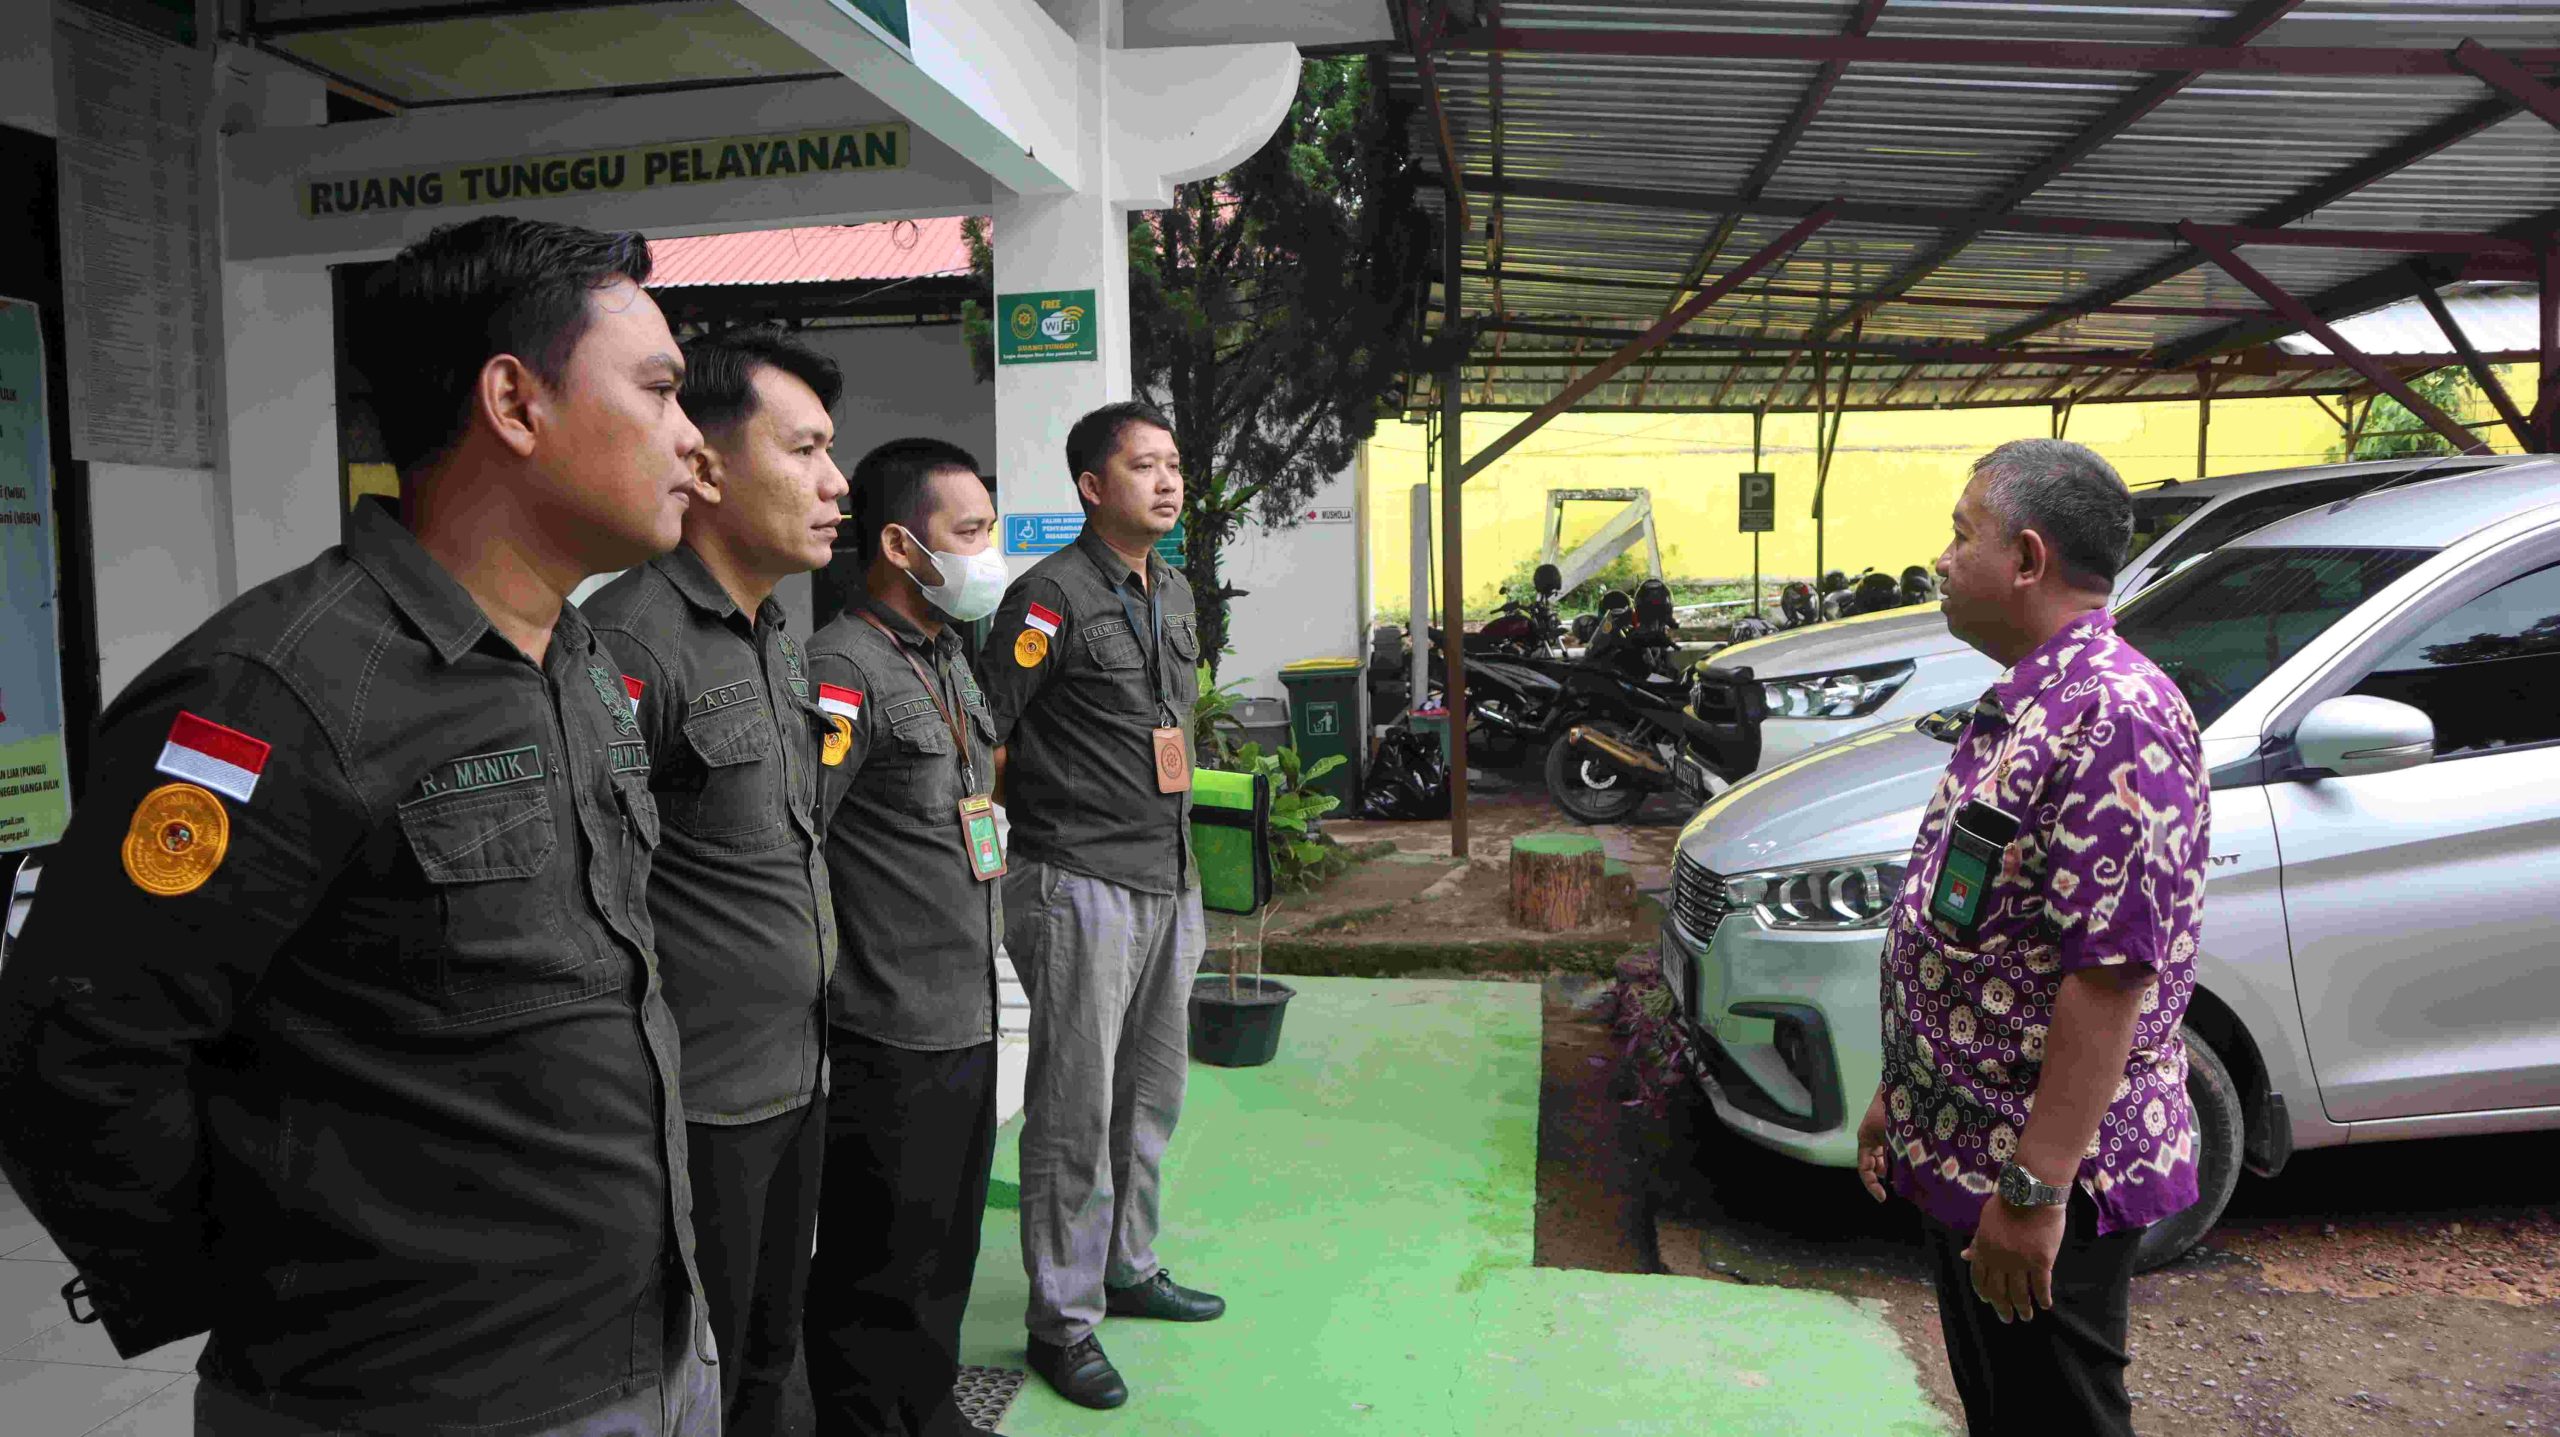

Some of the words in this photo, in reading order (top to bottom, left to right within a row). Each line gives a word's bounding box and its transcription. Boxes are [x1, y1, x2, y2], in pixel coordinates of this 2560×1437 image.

[311, 171, 443, 216] RUANG
[460, 155, 627, 201] TUNGGU
[644, 130, 897, 186] PELAYANAN
[1041, 300, 1061, 309] FREE
[1745, 477, 1770, 508] P
[1321, 510, 1351, 520] MUSHOLLA
[453, 754, 526, 788] MANIK
[20, 782, 42, 794] NANGA
